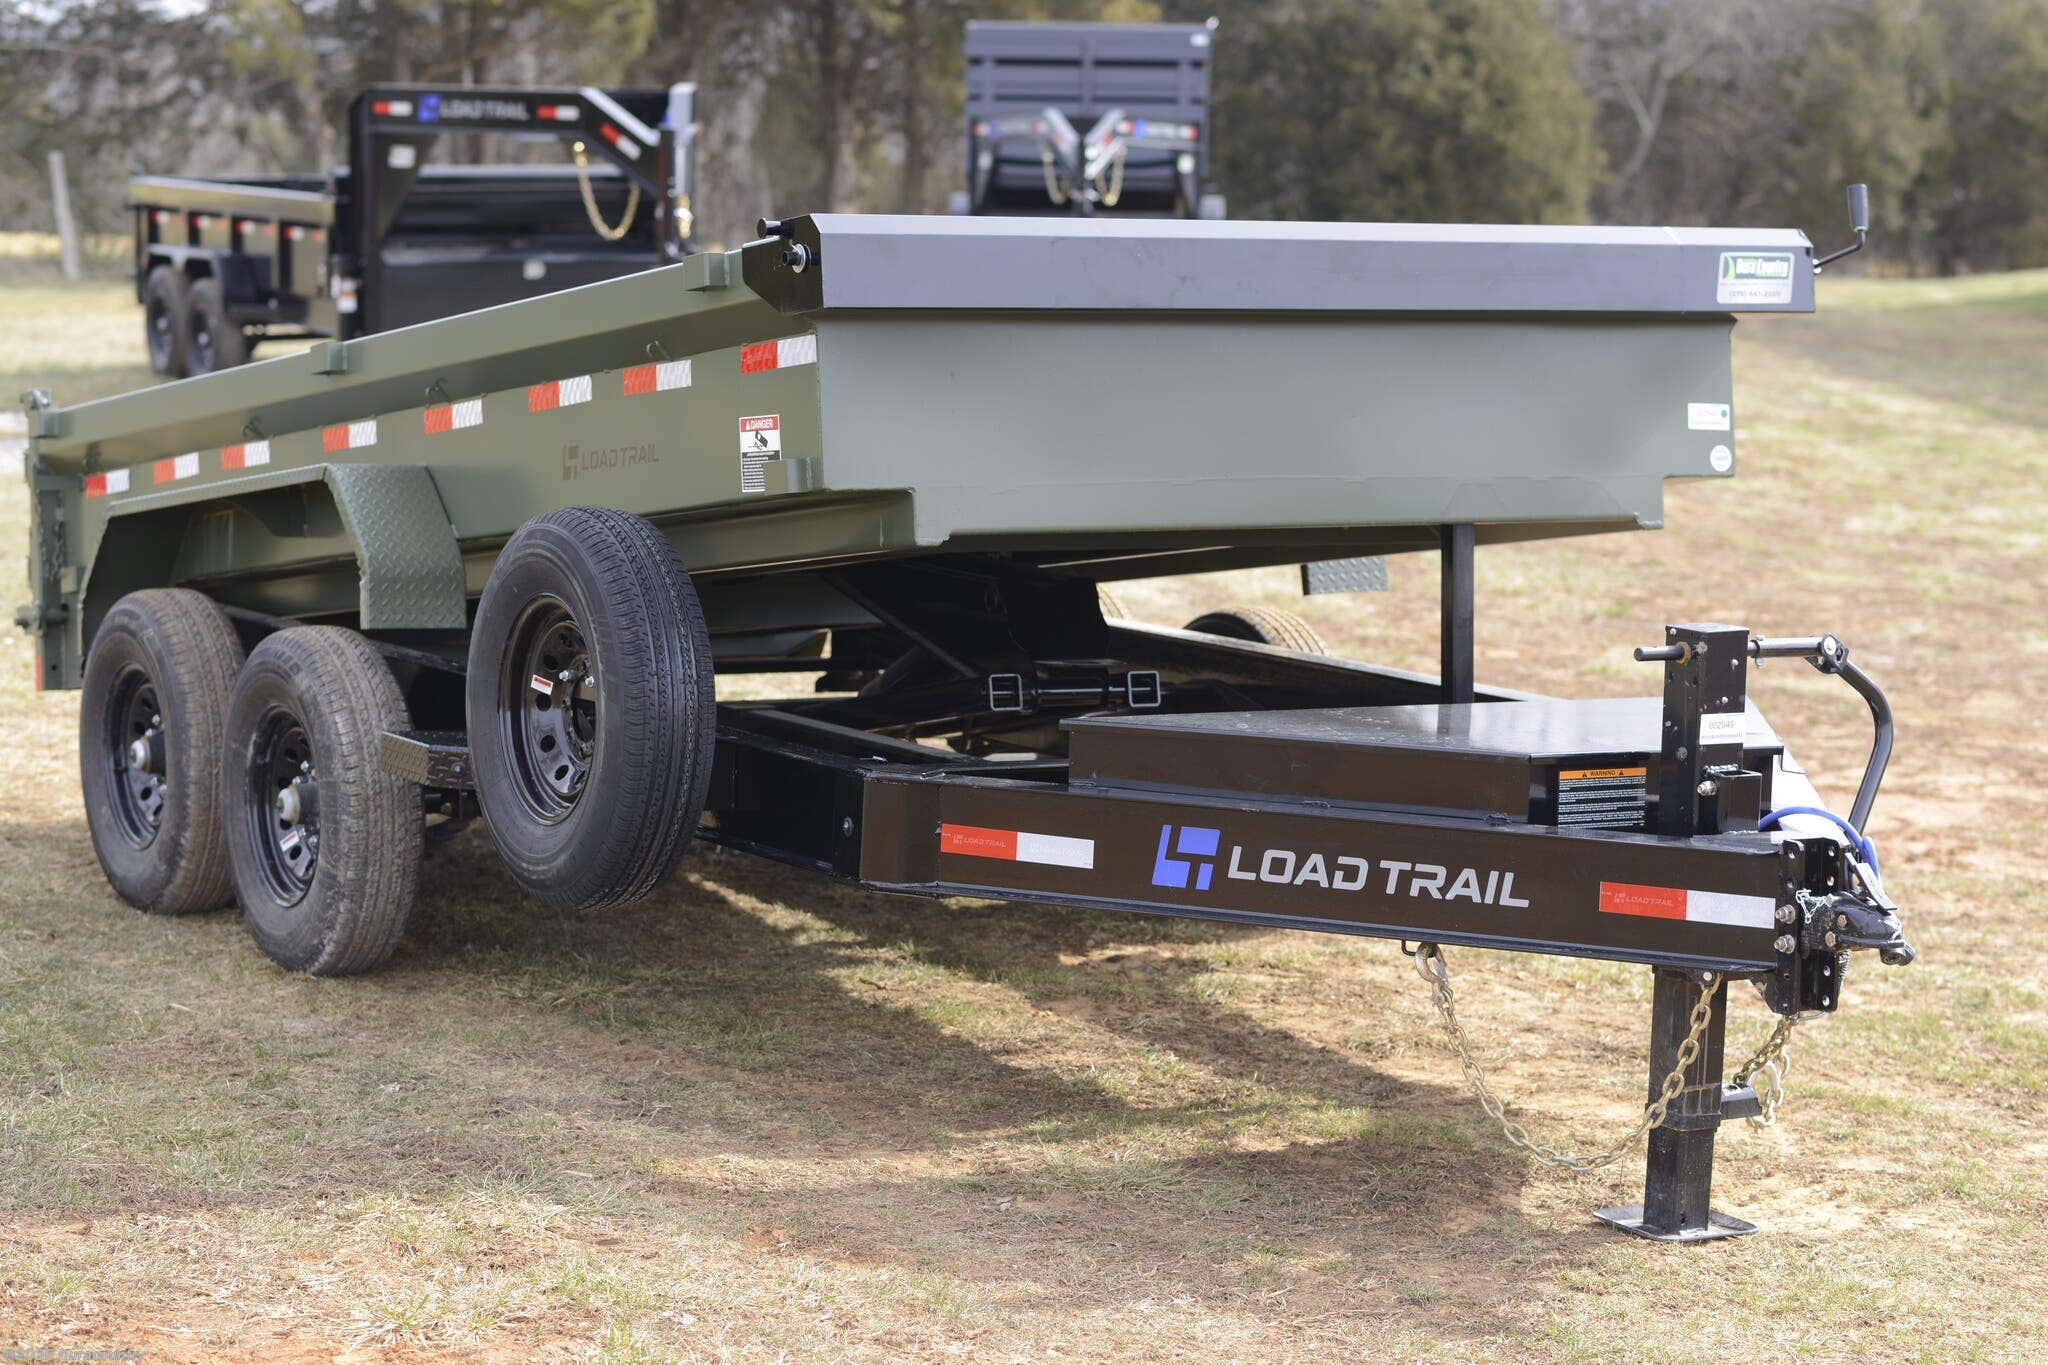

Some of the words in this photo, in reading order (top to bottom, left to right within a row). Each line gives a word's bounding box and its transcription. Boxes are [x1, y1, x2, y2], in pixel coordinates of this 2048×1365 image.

[750, 418, 774, 430] DANGER
[581, 449, 618, 471] LOAD
[620, 444, 660, 467] TRAIL
[965, 837, 984, 845] LOAD
[985, 840, 1007, 848] TRAIL
[1228, 845, 1369, 891] LOAD
[1379, 860, 1530, 908] TRAIL
[1626, 896, 1649, 904] LOAD
